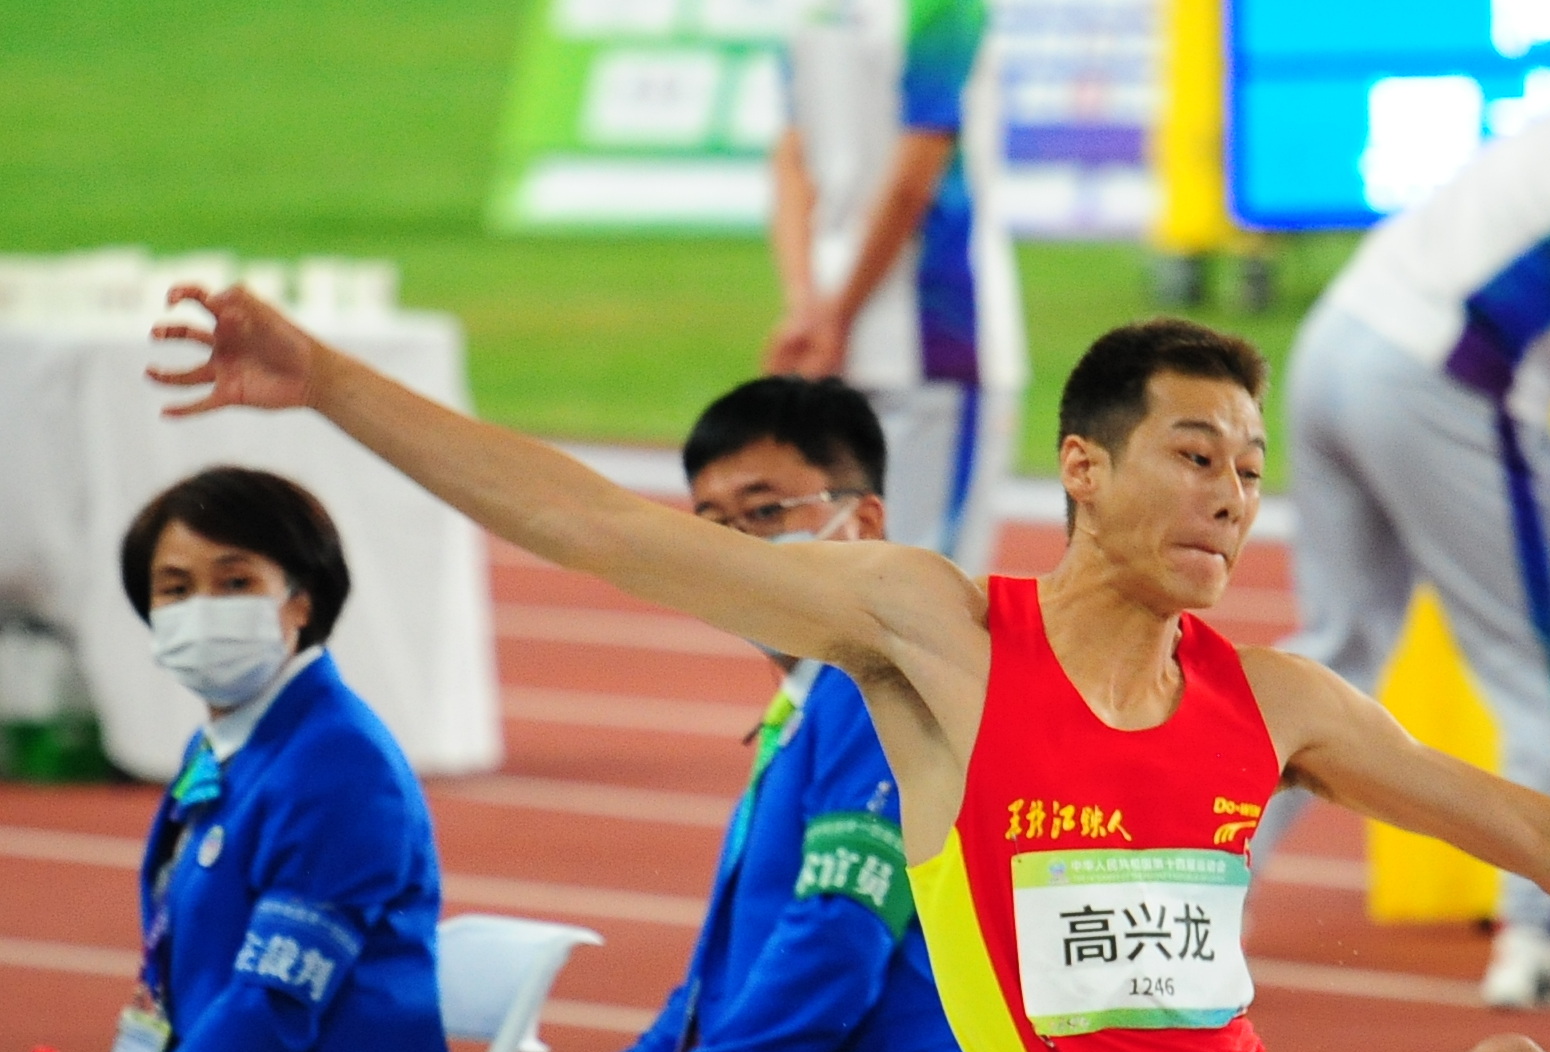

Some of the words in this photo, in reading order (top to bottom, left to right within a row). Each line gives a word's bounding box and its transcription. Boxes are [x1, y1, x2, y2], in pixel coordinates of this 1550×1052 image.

[1060, 902, 1215, 966] 高兴龙
[1129, 977, 1175, 996] 1246
